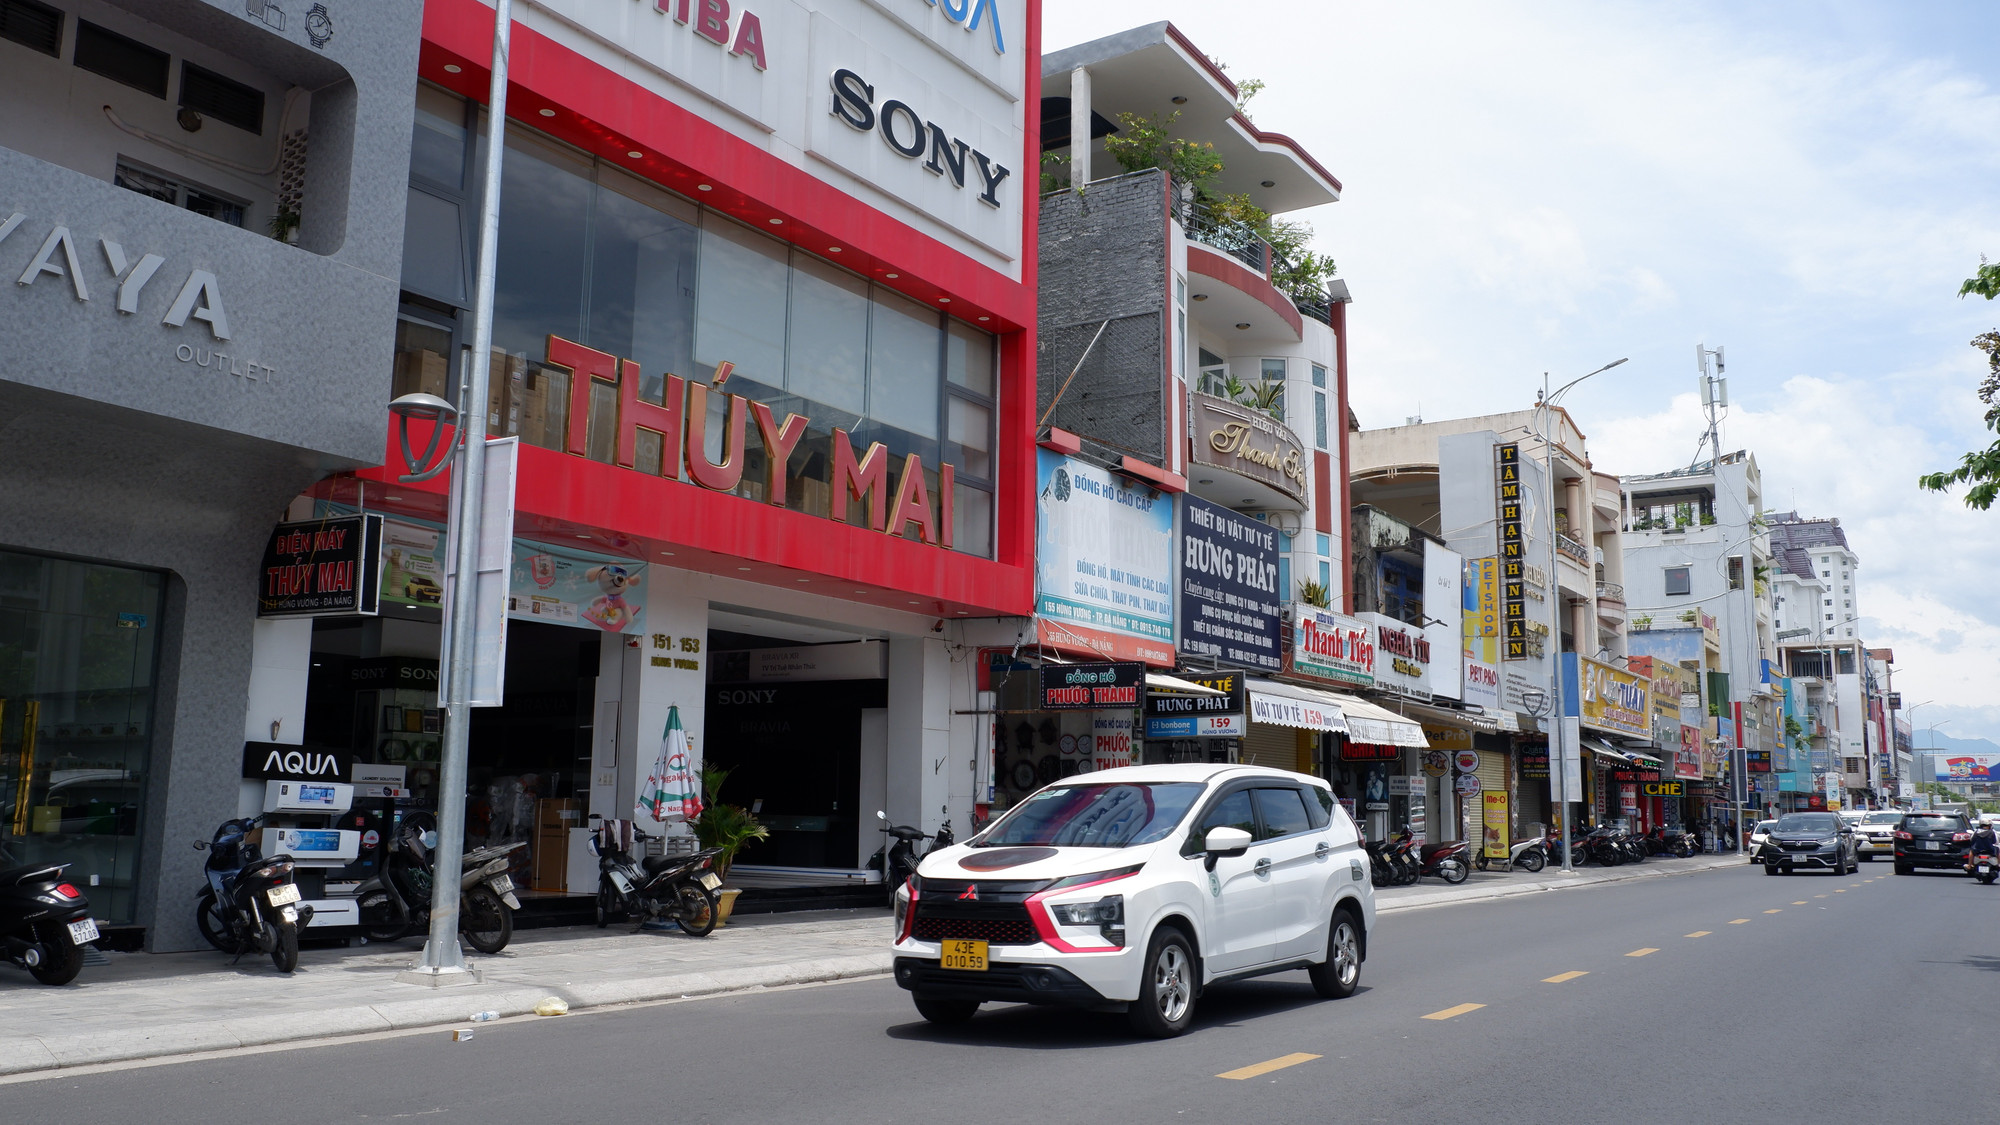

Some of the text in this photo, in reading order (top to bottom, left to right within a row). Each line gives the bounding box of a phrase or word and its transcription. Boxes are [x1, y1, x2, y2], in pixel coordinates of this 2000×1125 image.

[829, 68, 1010, 209] SONY
[0, 212, 231, 341] AYA
[176, 344, 275, 383] OUTLET
[547, 334, 955, 548] THÚY MAI
[1116, 489, 1133, 507] CAO
[1190, 505, 1273, 551] THIẾT BỊ VẬT TƯ Y TẾ
[277, 526, 348, 557] ĐIỆN MÁY
[1185, 535, 1276, 594] HƯNG PHÁT
[268, 557, 354, 596] THÚY MAI
[1142, 576, 1155, 592] CÁC
[1044, 601, 1055, 613] 155
[1112, 590, 1128, 606] THAY
[679, 637, 700, 654] 153
[1302, 618, 1344, 660] Thanh
[1348, 627, 1373, 673] Tiếp
[1216, 675, 1234, 692] TẾ
[1469, 664, 1497, 687] PET PRO
[718, 689, 778, 705] SONY
[1047, 684, 1136, 704] PHƯỚC THÀNH
[1156, 695, 1231, 712] HƯNG PHÁT
[1618, 677, 1646, 714] TUẤN
[1254, 698, 1271, 722] VẬT
[1271, 703, 1283, 720] TƯ
[1284, 705, 1290, 720] Y
[1290, 701, 1301, 723] TẾ
[1303, 708, 1323, 726] 159
[1116, 720, 1125, 729] CAO
[1160, 721, 1191, 729] bonbone
[1210, 717, 1231, 728] 159
[1096, 731, 1130, 752] PHƯỚC
[263, 750, 340, 776] AQUA
[1645, 780, 1682, 796] CHÈ
[1486, 795, 1506, 804] Me-O
[954, 941, 975, 954] 43E
[946, 955, 983, 968] 010.59
